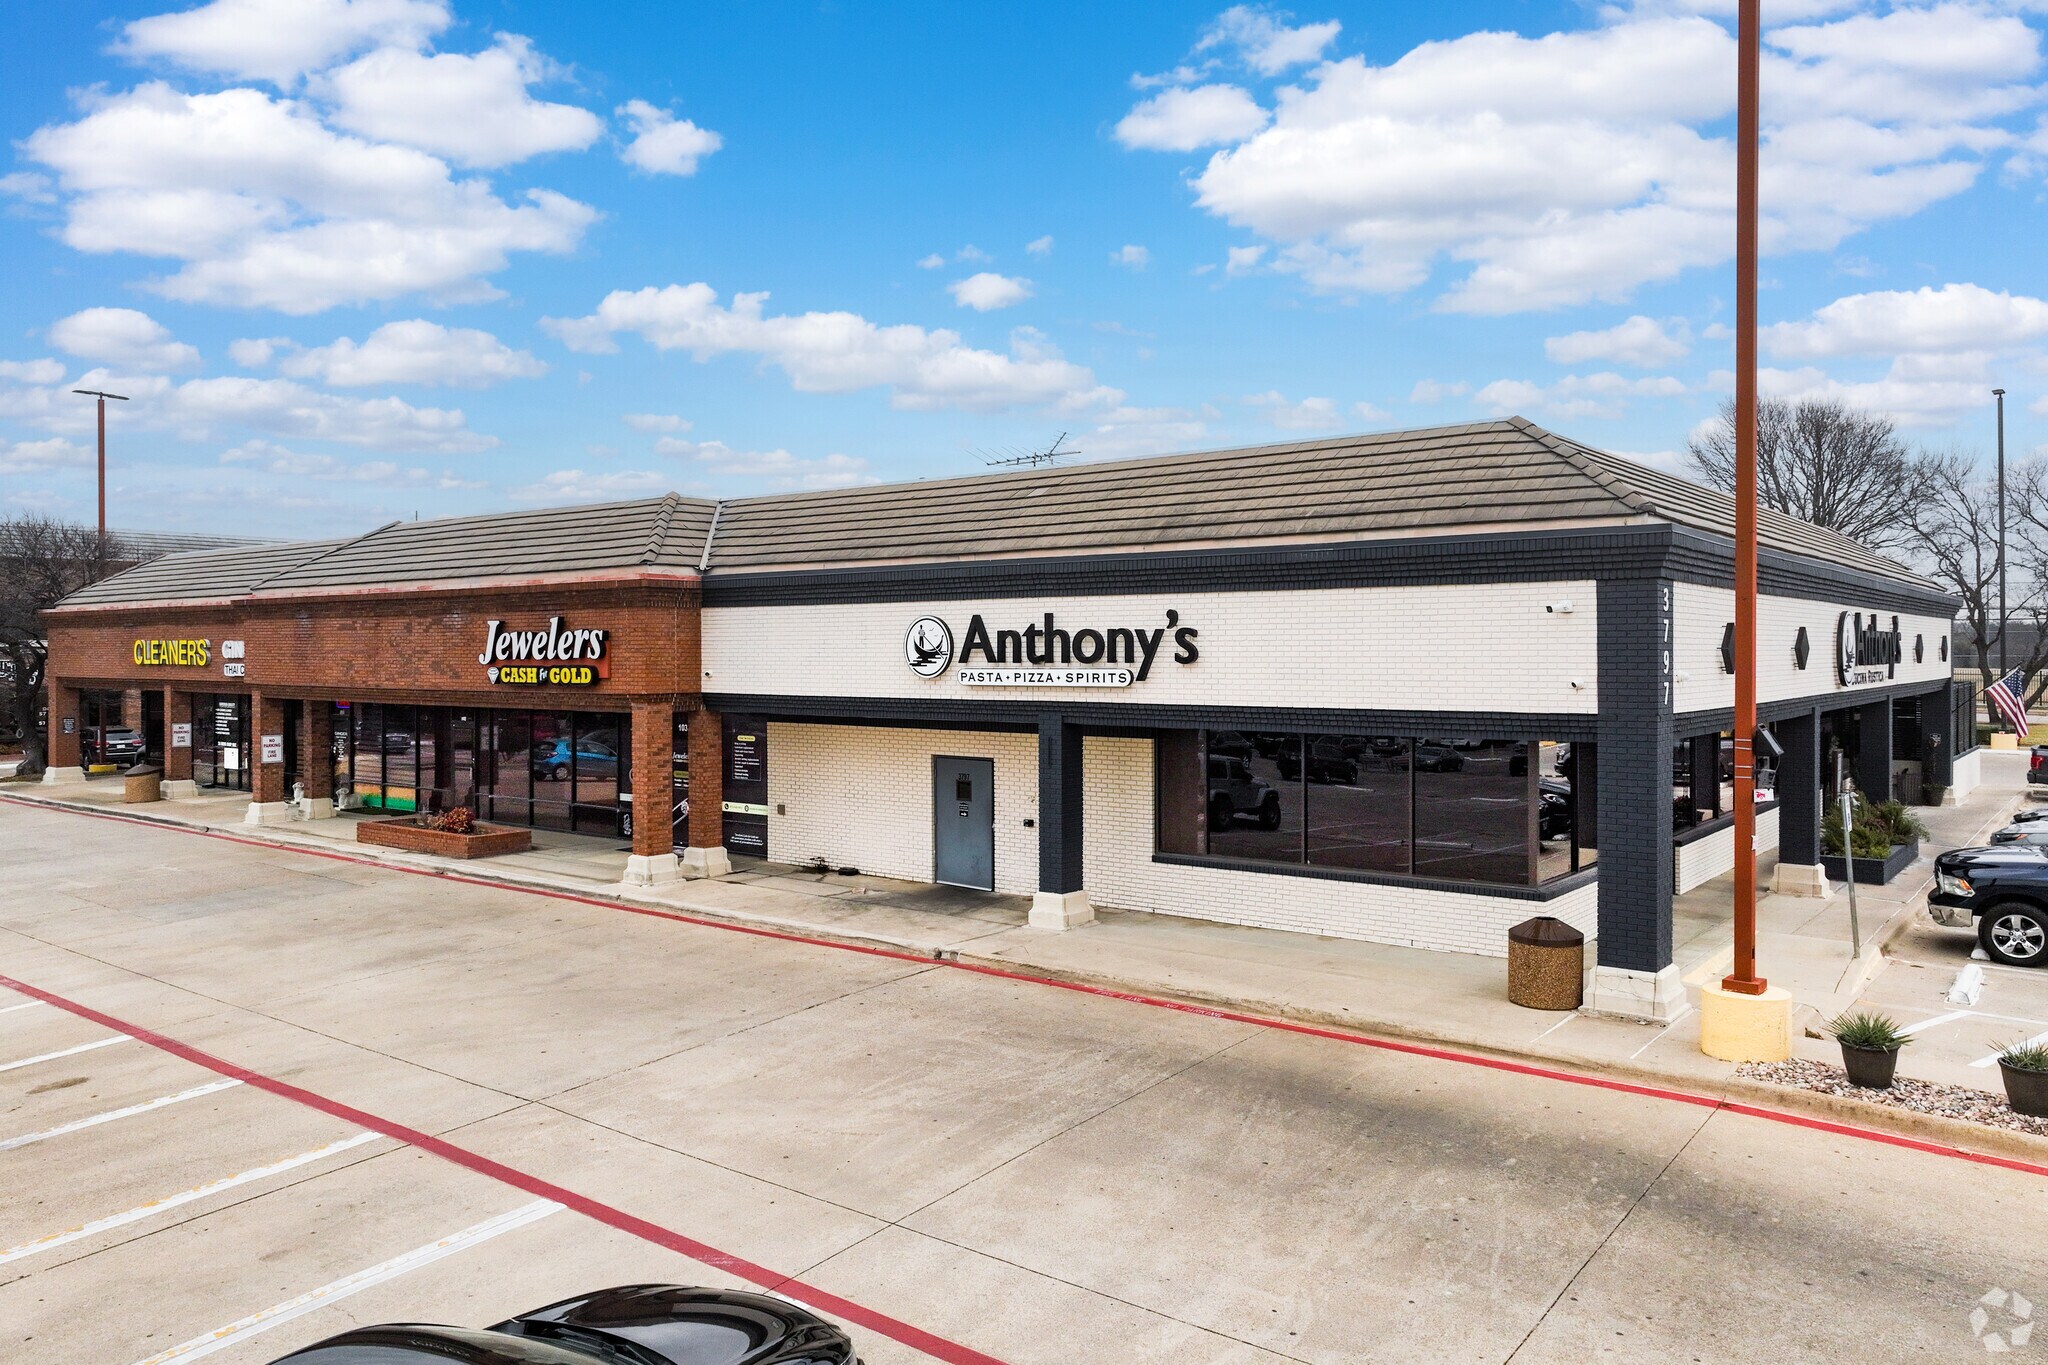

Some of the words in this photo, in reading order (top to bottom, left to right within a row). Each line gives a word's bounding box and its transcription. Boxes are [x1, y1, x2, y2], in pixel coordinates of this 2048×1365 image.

[133, 639, 209, 667] CLEANERS
[478, 616, 604, 665] Jewelers
[958, 608, 1199, 682] Anthony's
[1854, 611, 1902, 680] Anthony's
[225, 665, 239, 675] THAI
[500, 667, 538, 683] CASH
[550, 668, 592, 684] GOLD
[960, 672, 1002, 683] PASTA
[1016, 672, 1054, 683] PIZZA
[1065, 672, 1128, 684] SPIRITS
